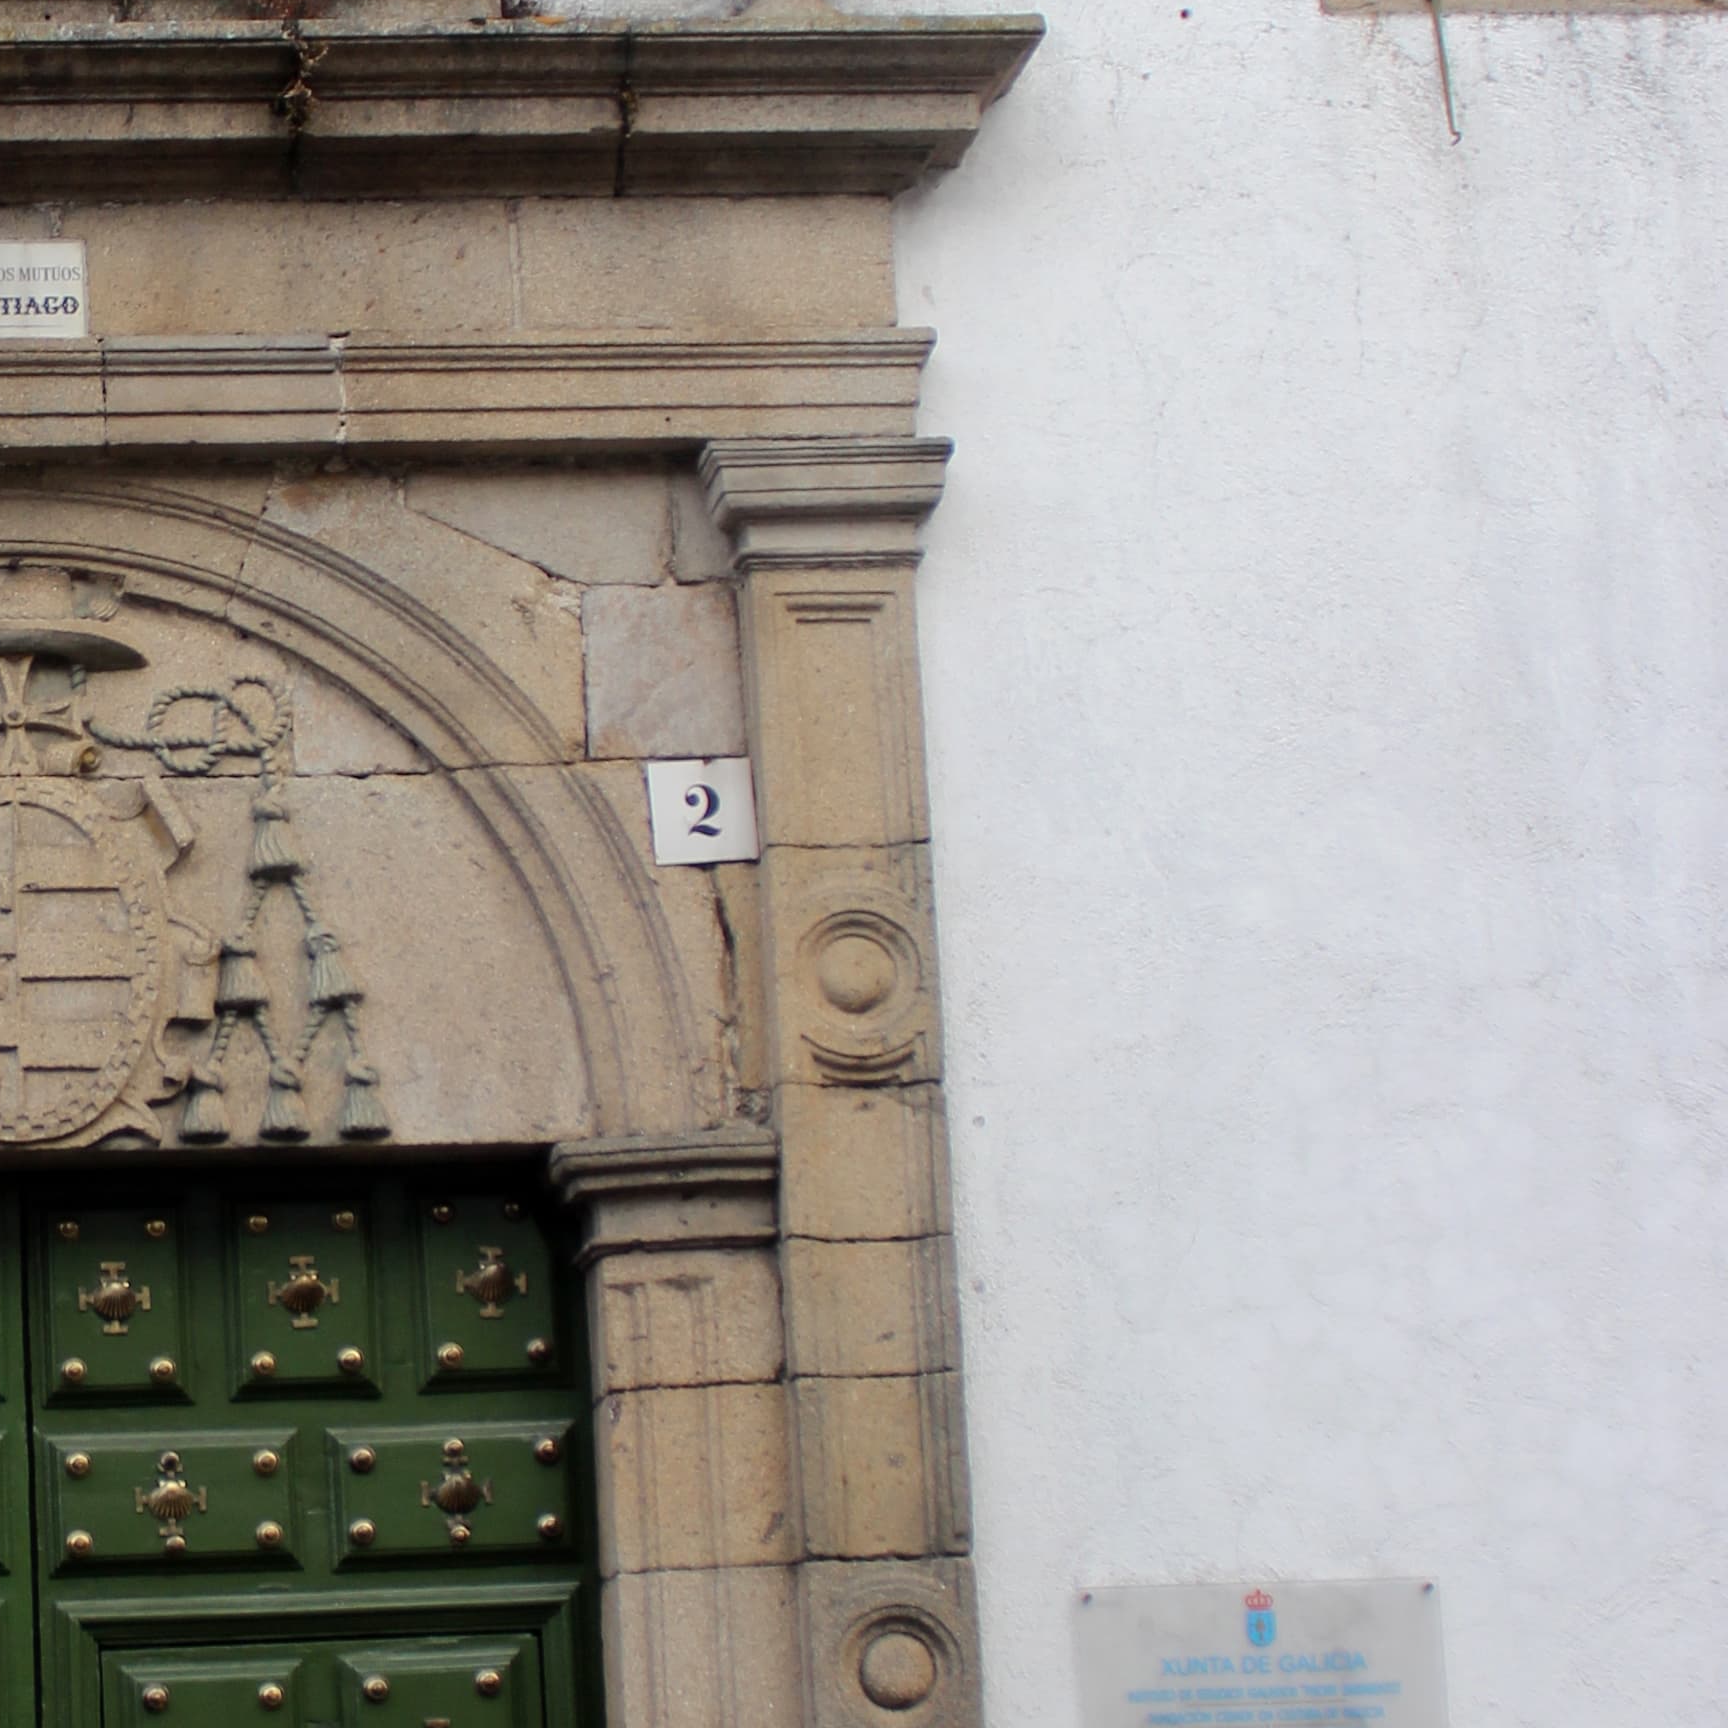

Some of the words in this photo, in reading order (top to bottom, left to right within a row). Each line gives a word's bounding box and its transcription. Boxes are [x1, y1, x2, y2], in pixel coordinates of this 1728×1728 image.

[18, 266, 82, 282] MUTUOS
[684, 783, 722, 838] 2
[1160, 1654, 1235, 1677] XUNTA
[1242, 1652, 1272, 1675] DE
[1279, 1649, 1369, 1674] GALICIA
